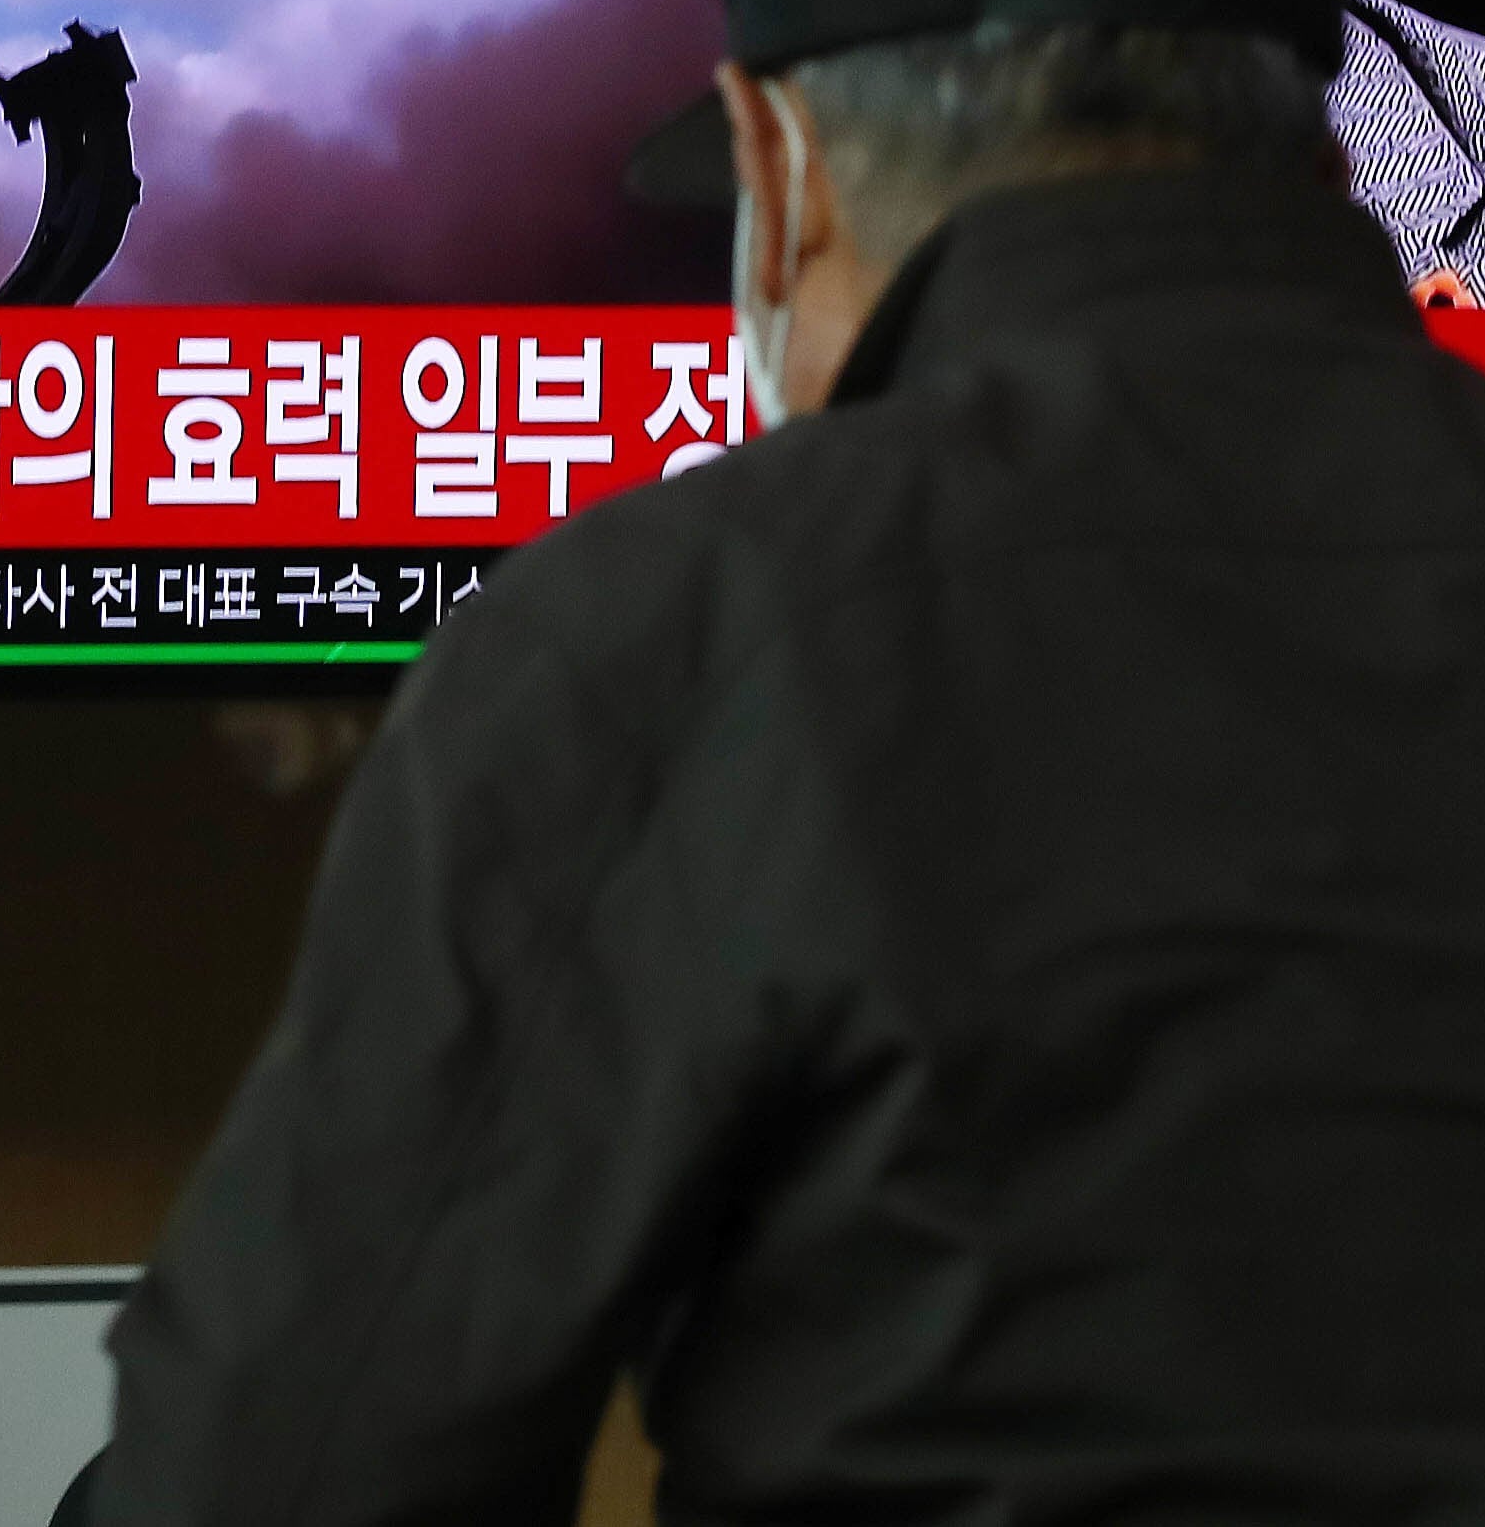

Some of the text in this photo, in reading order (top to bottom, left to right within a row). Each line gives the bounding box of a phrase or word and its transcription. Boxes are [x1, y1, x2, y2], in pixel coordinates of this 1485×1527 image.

[147, 335, 360, 519] 효력
[402, 335, 613, 517] 일부
[91, 564, 138, 629] 전
[158, 563, 261, 628] 대표
[276, 564, 382, 628] 구속
